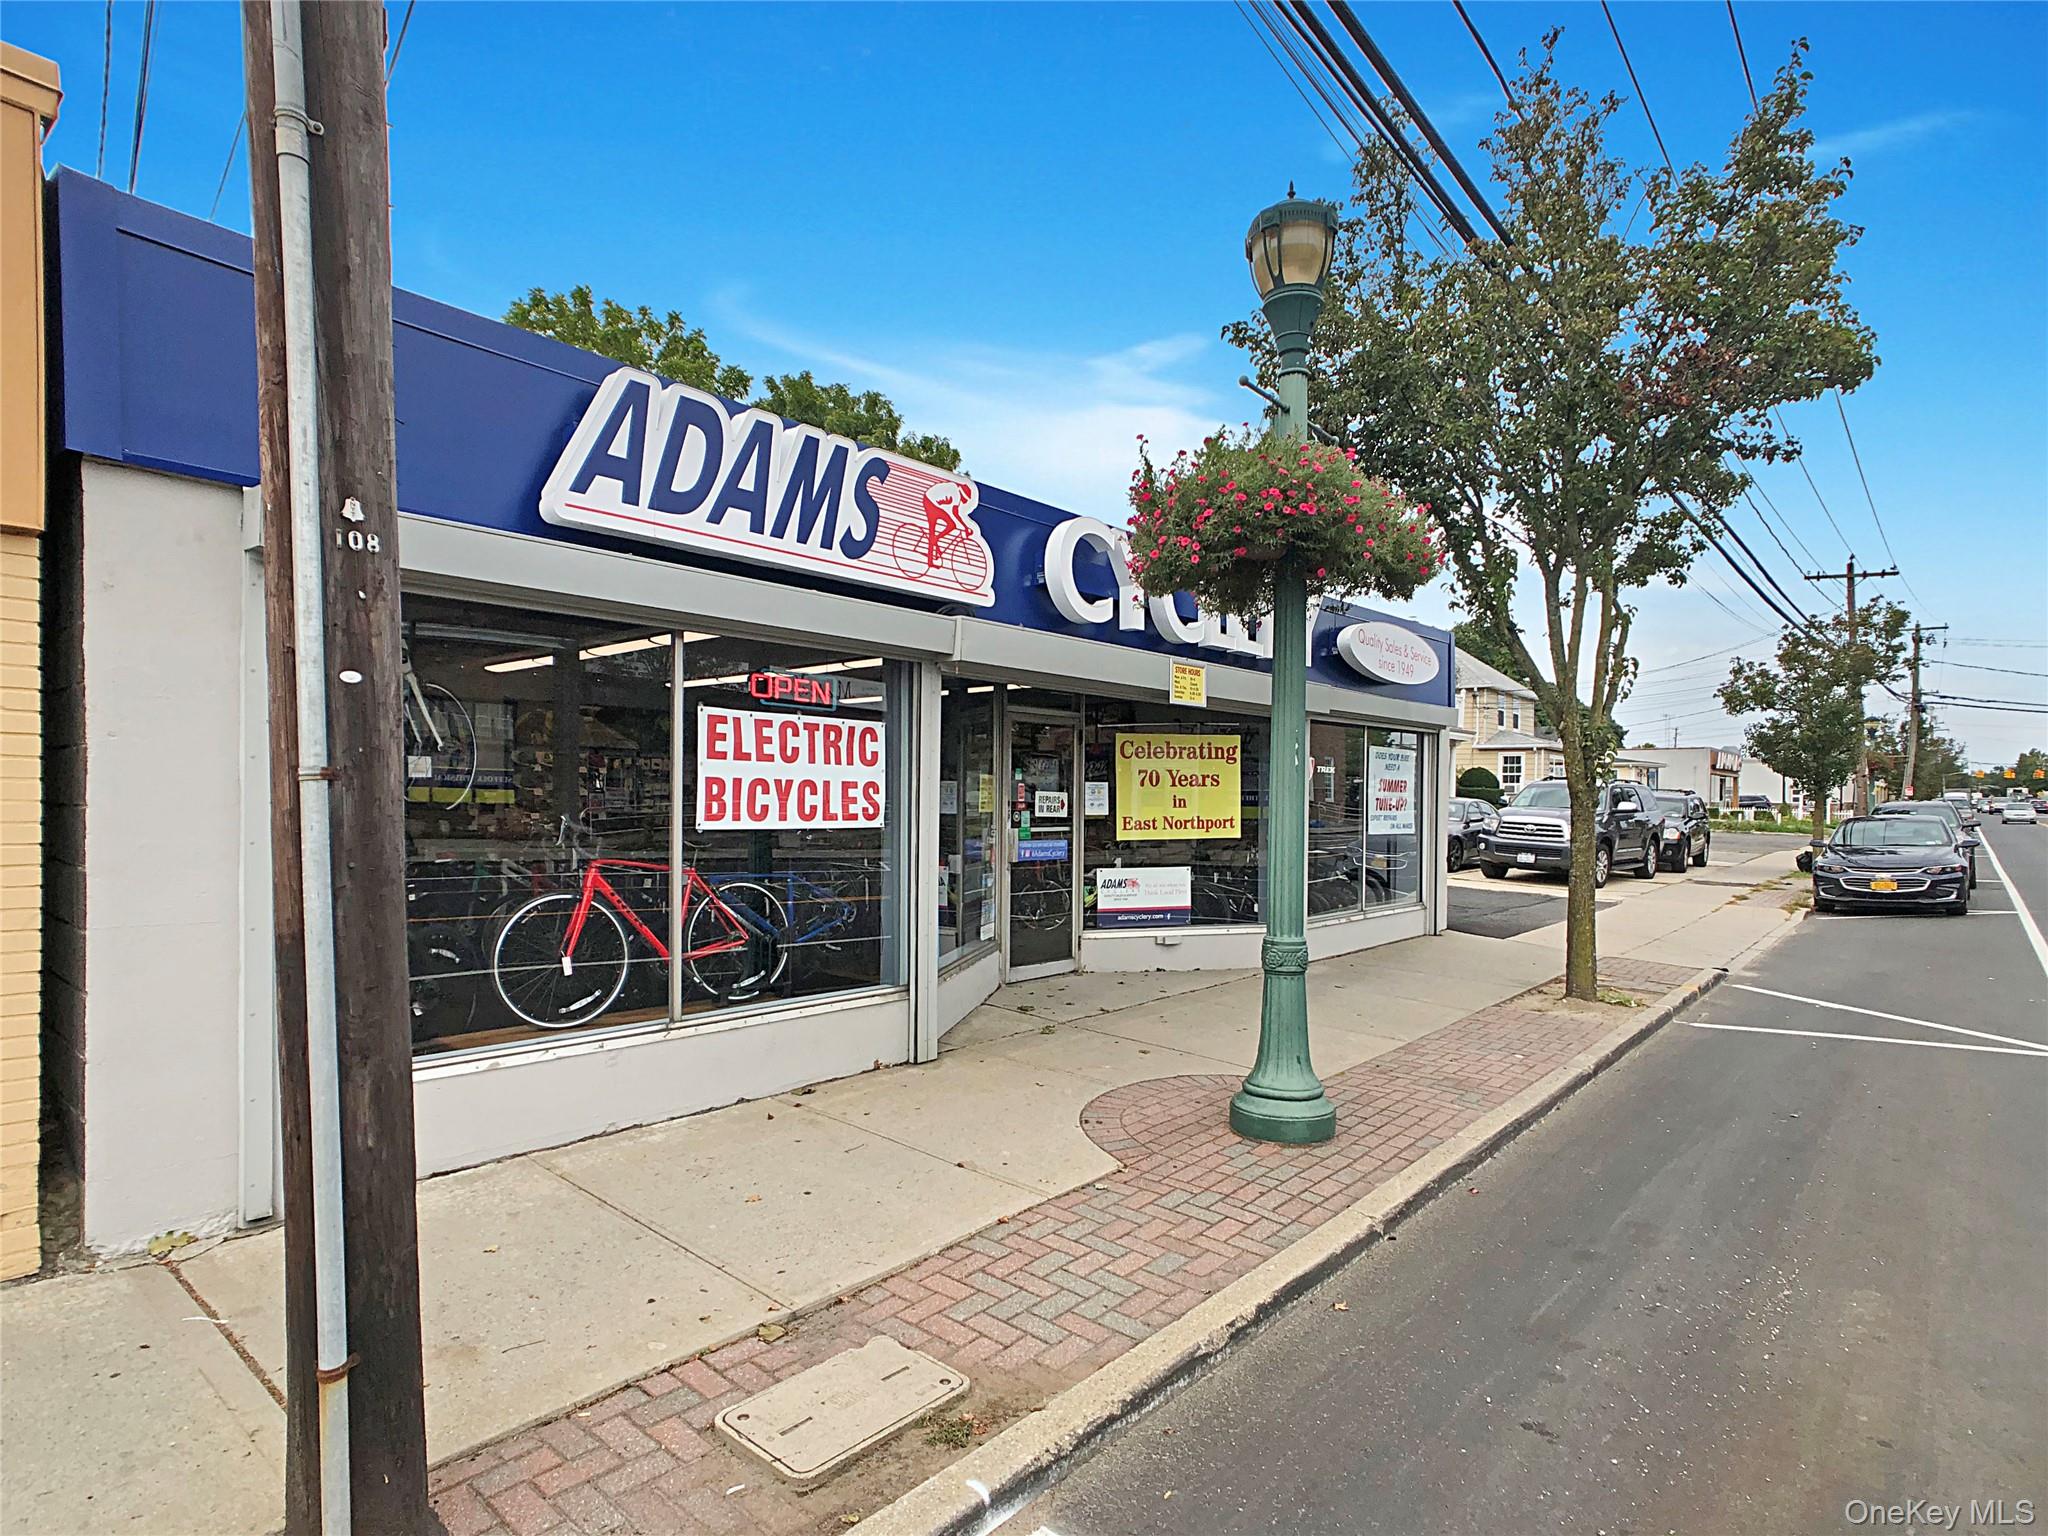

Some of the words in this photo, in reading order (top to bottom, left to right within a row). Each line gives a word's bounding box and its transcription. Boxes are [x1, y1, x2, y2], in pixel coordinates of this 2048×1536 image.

[569, 380, 889, 559] ADAMS
[335, 527, 380, 553] 108
[1358, 629, 1383, 652] Quality
[1385, 638, 1402, 657] Sales
[1410, 646, 1431, 666] Service
[1378, 656, 1395, 672] since
[1397, 660, 1414, 678] 1949
[750, 672, 831, 705] OPEN
[706, 714, 879, 767] ELECTRIC
[1120, 740, 1238, 764] Celebrating
[1138, 769, 1160, 787] 70
[1166, 769, 1220, 787] Years
[1378, 779, 1407, 793] SUMMER
[703, 777, 880, 822] BICYCLES
[1038, 795, 1060, 804] REPAIRS
[1038, 804, 1045, 813] IN
[1046, 804, 1060, 813] REAR
[1172, 795, 1187, 808] in
[1375, 798, 1408, 812] TUNE-UP?
[1122, 816, 1158, 830] East
[1162, 815, 1235, 832] Northport
[1101, 878, 1127, 889] ADAMS
[1117, 913, 1163, 922] adamscyclery.com
